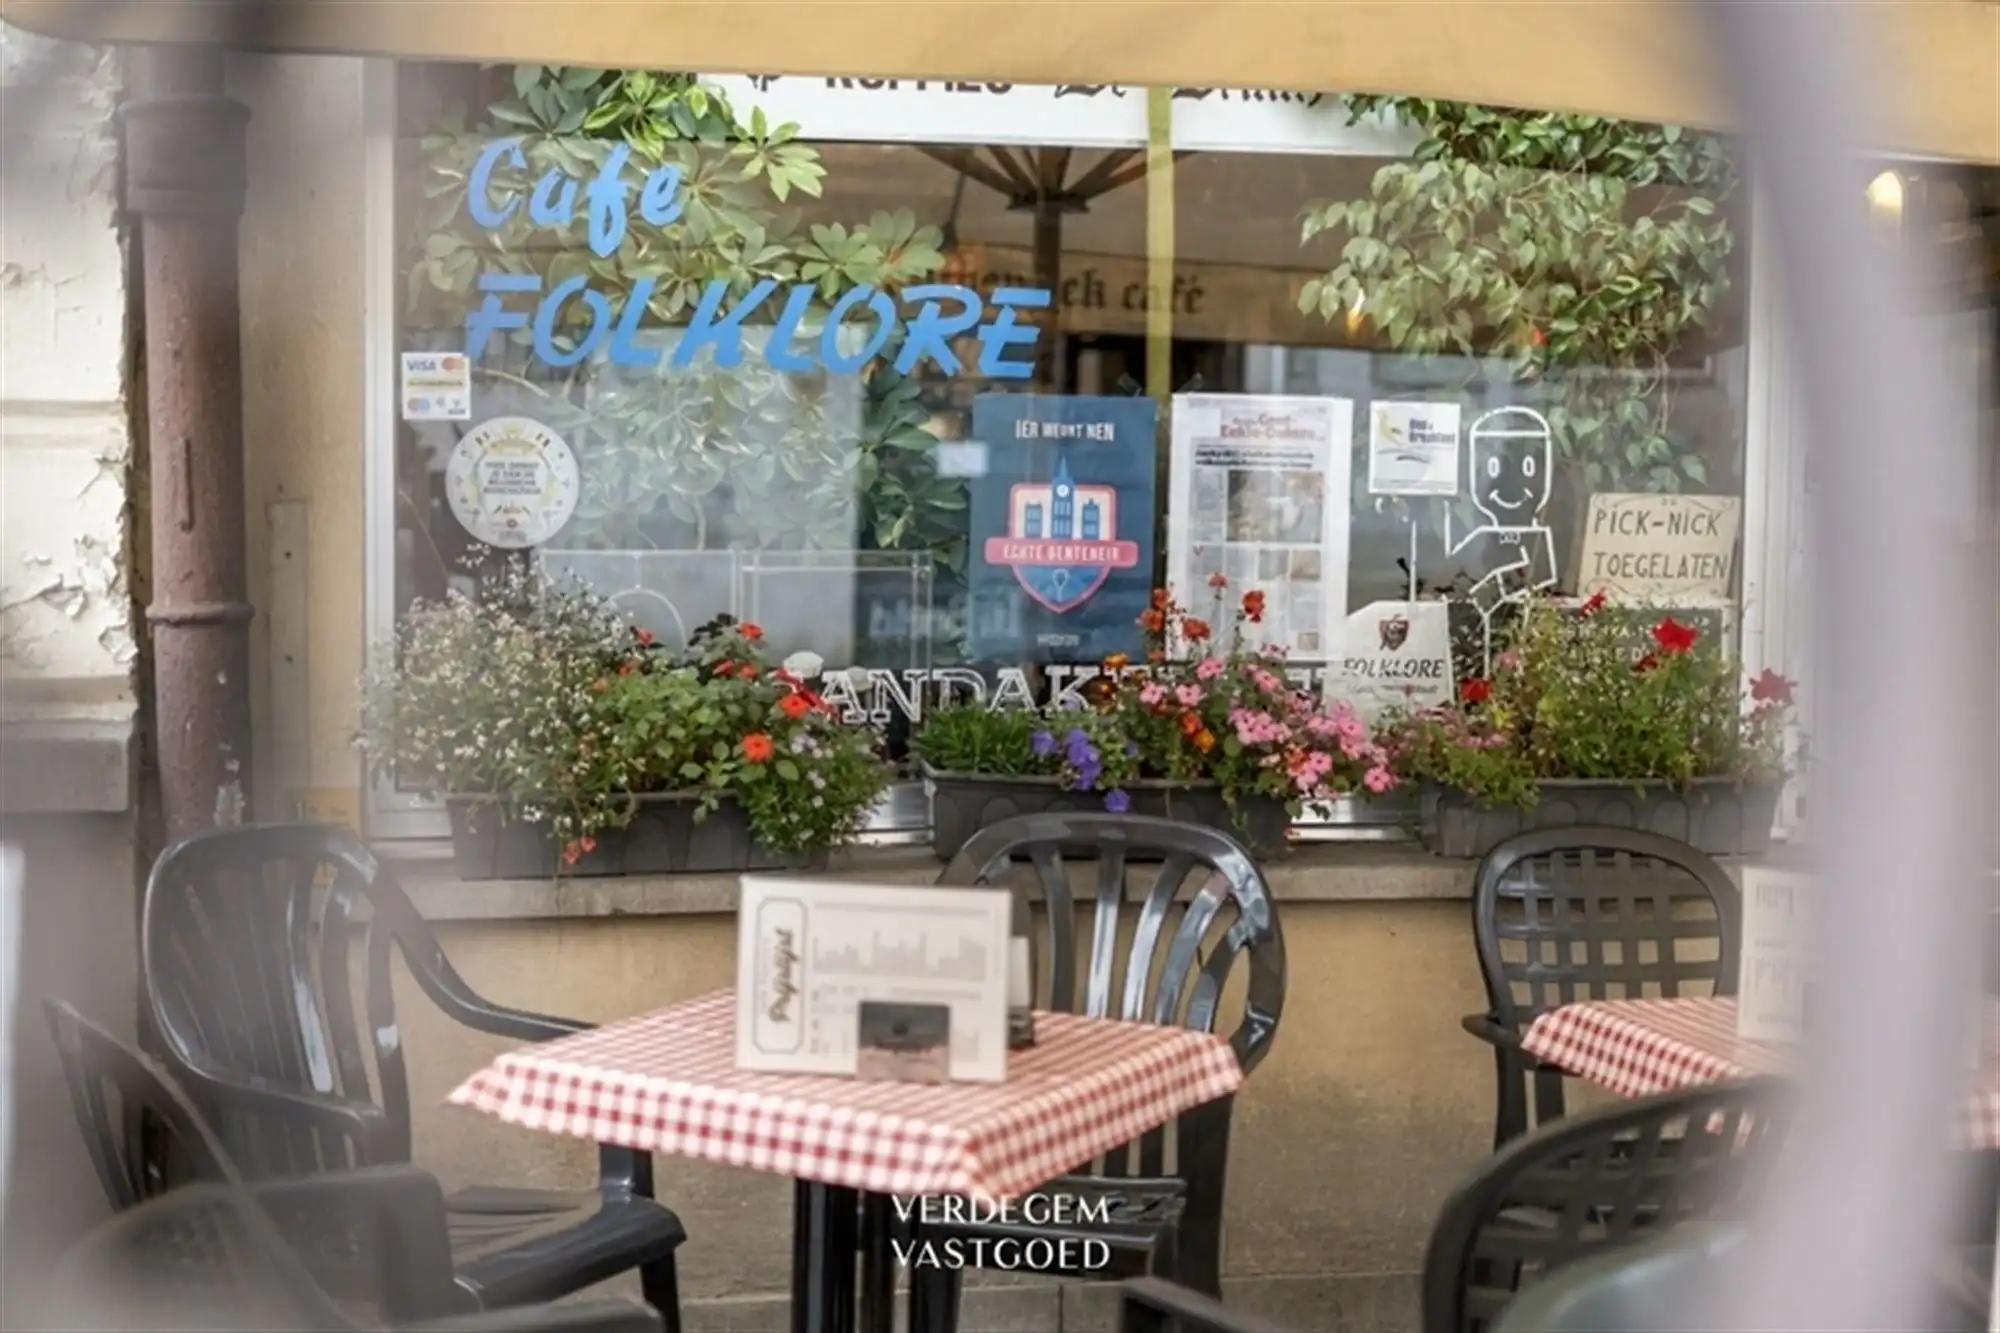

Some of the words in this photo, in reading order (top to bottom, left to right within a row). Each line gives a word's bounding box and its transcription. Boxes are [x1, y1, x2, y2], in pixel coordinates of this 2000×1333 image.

[464, 273, 1051, 379] FOLKLORE
[407, 360, 437, 372] VISA
[1086, 422, 1116, 442] NEN
[1594, 508, 1722, 536] PICK-NICK
[1592, 551, 1729, 579] TOEGELATEN
[1342, 657, 1444, 678] FOLKLORE
